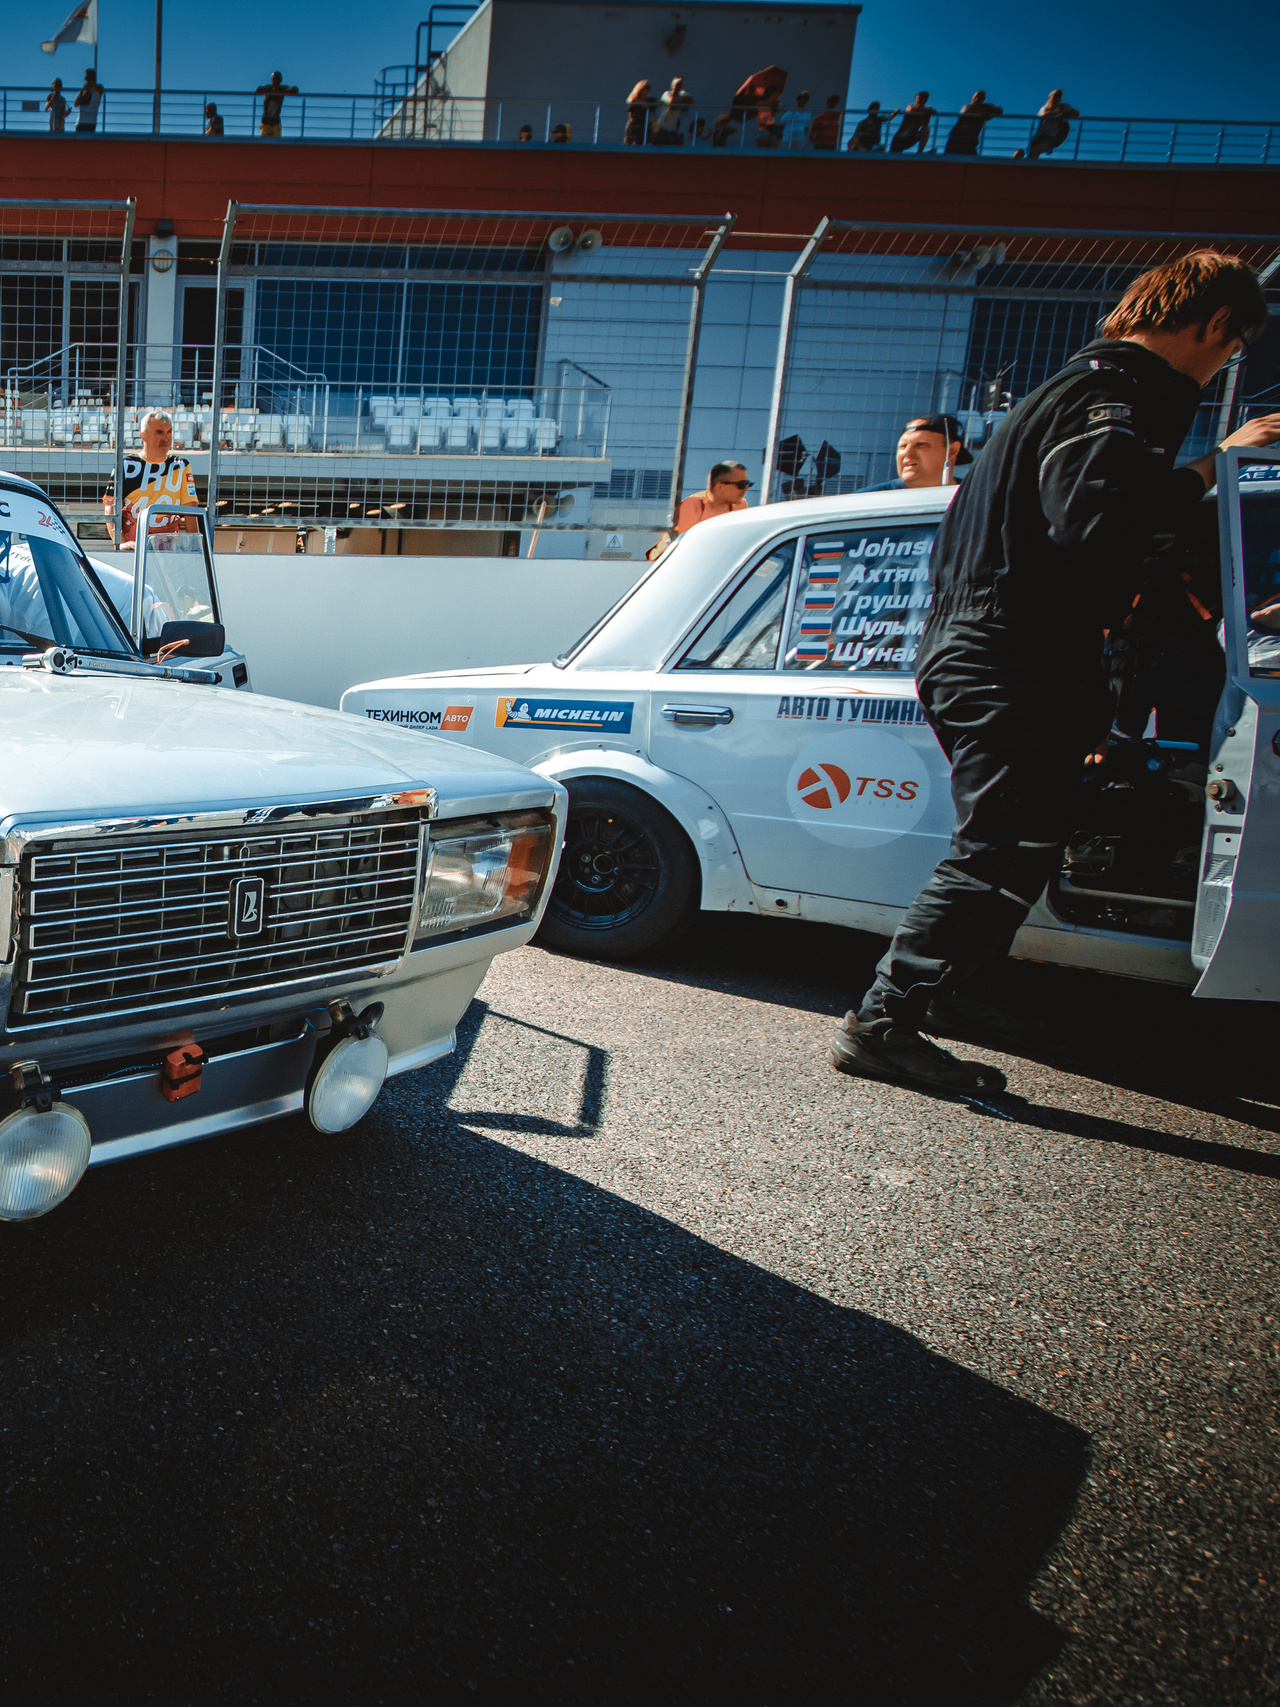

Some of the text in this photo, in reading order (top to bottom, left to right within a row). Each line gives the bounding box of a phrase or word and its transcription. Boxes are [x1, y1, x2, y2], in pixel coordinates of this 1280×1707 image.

[123, 459, 186, 493] PRO
[848, 537, 936, 558] Johns
[365, 709, 469, 724] ТЕХИНКОМ АВТО
[533, 708, 625, 722] MICHELIN
[776, 696, 830, 720] АВТО
[855, 776, 919, 801] TSS
